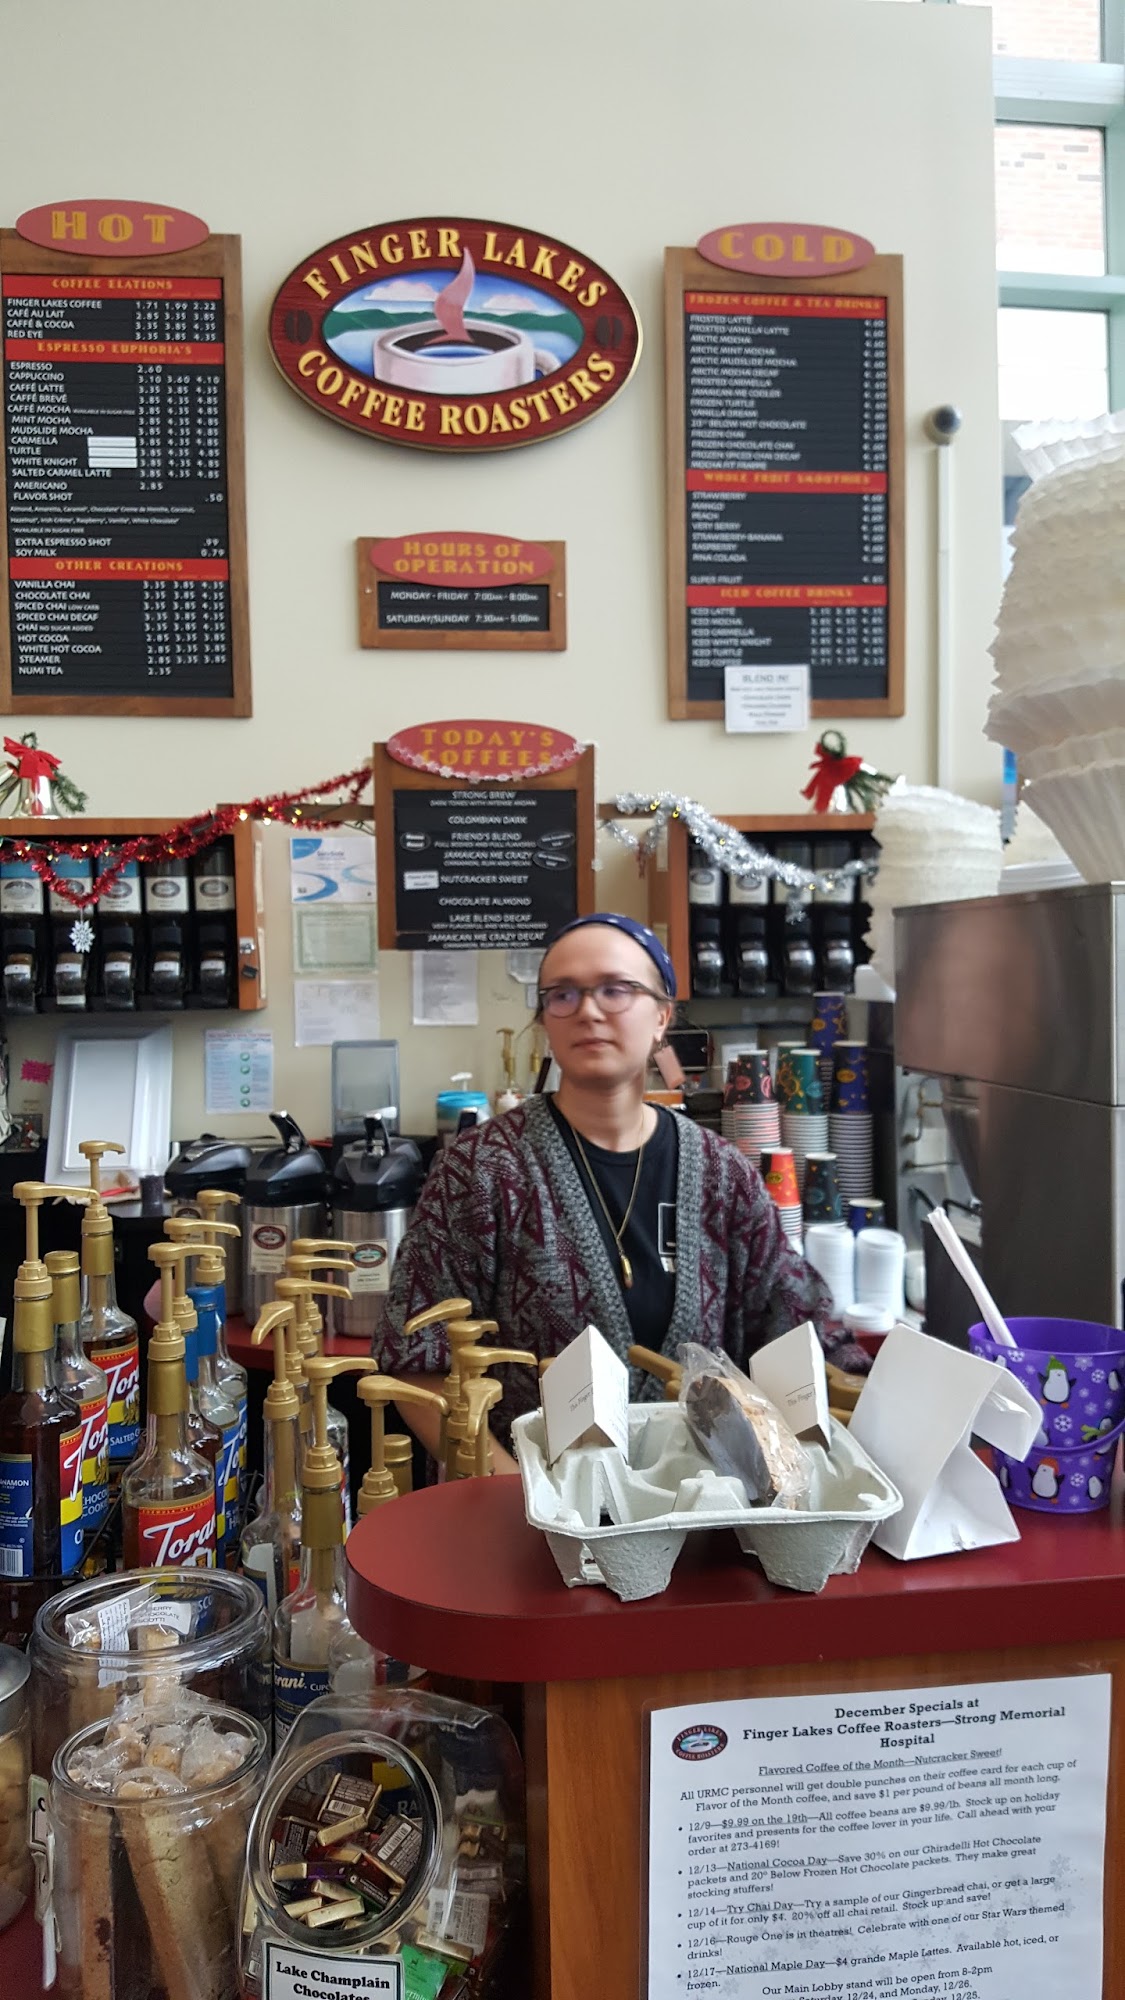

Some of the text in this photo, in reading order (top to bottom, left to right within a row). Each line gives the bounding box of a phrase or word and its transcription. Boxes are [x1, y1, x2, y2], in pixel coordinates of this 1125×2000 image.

[52, 211, 176, 244] HOT
[718, 231, 855, 264] COLD
[303, 228, 608, 308] FINGER LAKES
[52, 279, 172, 289] COFFEE ELATIONS
[8, 298, 40, 306] FINGER
[69, 300, 101, 308] COFFEE
[7, 308, 28, 317] CAFÉ
[38, 343, 104, 352] ESPRESSO
[11, 362, 52, 370] ESPRESSO
[9, 372, 64, 381] CAPPUCCINO
[297, 350, 616, 436] COFFEE ROASTERS
[11, 426, 57, 434] MUDSLIDE
[11, 436, 58, 444] CARMELLA
[8, 446, 40, 455] TURTLE
[47, 468, 83, 476] CARMEL
[404, 542, 523, 557] HOURS OF
[56, 561, 182, 571] OTHER CREATIONS
[394, 559, 535, 574] OPERATION
[387, 615, 469, 624] SATURDAY/SUNDAY
[421, 729, 554, 747] TODAY'S
[422, 750, 552, 766] COFFEES
[110, 1432, 134, 1446] SALTED
[835, 1699, 978, 1718] December Specials at
[744, 1729, 788, 1741] Finger
[793, 1726, 832, 1736] Lakes
[837, 1723, 880, 1734] Coffee
[1000, 1707, 1065, 1720] Memorial
[880, 1734, 934, 1748] Hospital
[759, 1764, 804, 1776] Flavored
[806, 1763, 841, 1773] Coffee
[843, 1762, 853, 1771] of
[855, 1761, 872, 1770] the
[970, 1748, 1002, 1759] Sweet!
[680, 1791, 694, 1800] All
[697, 1788, 728, 1798] URMC
[732, 1783, 783, 1797] personnel
[786, 1782, 804, 1790] will
[807, 1782, 823, 1792] get
[826, 1779, 861, 1788] double
[864, 1777, 906, 1789] punches
[948, 1768, 978, 1778] coffee
[981, 1766, 1002, 1774] card
[1021, 1762, 1044, 1771] each
[688, 1846, 716, 1856] order
[731, 1840, 779, 1851] 273-4169!
[688, 1884, 773, 1899] stocking stuffers!
[688, 1948, 722, 1959] drinks!
[276, 1962, 308, 1979] Lake
[310, 1970, 390, 1989] Champlain
[688, 1981, 720, 1990] frozen.
